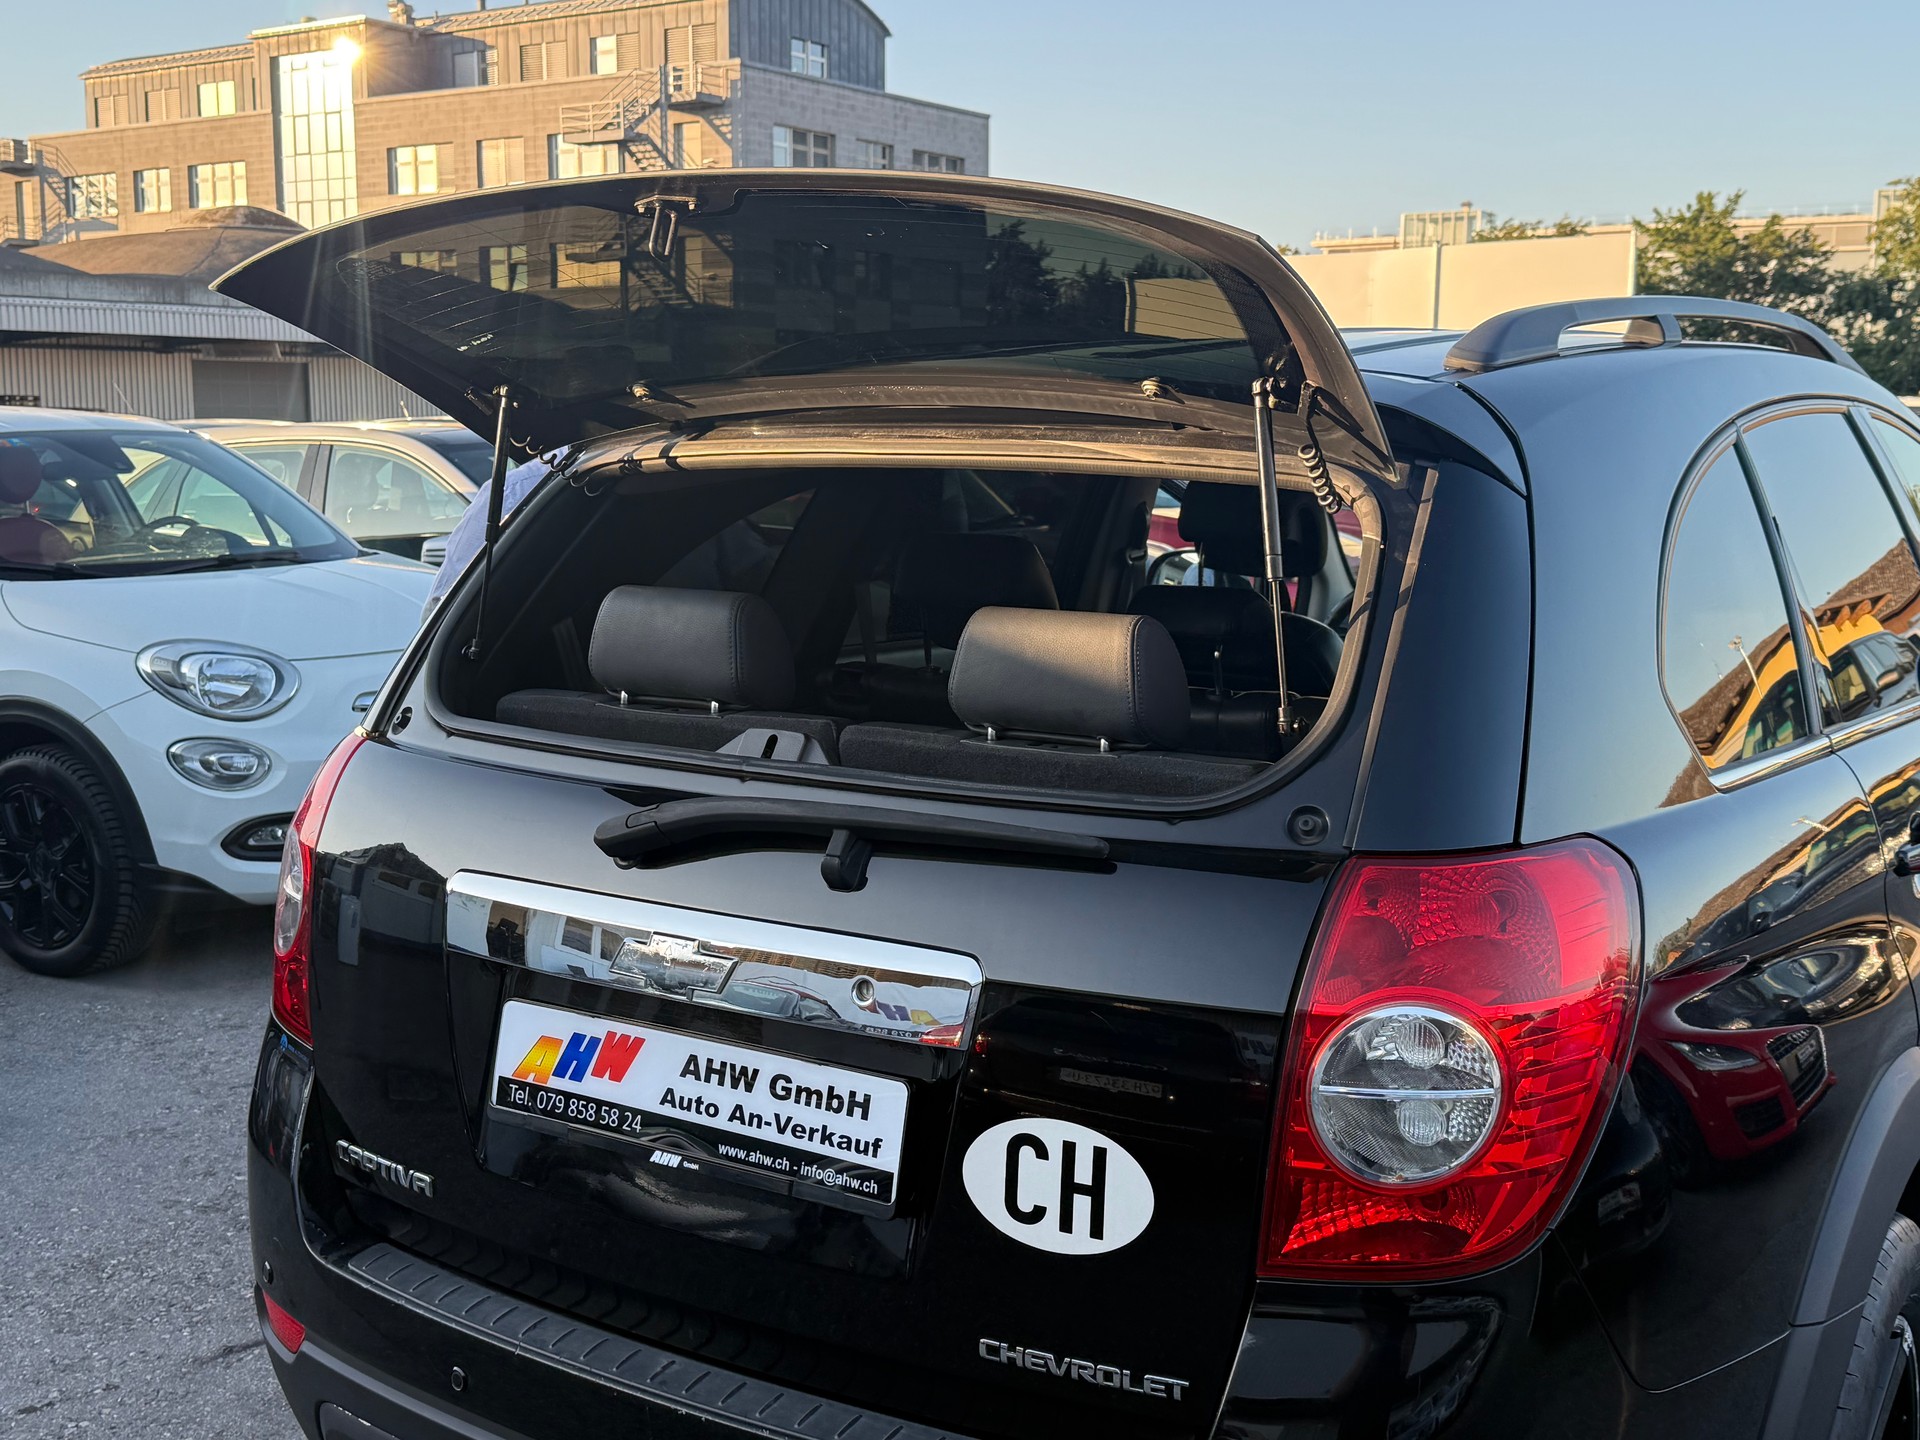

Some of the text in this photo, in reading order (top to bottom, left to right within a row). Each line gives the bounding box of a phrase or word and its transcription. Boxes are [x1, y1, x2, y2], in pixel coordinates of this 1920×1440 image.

[511, 1030, 646, 1085] AHW
[679, 1053, 872, 1121] AHW GmbH
[508, 1083, 642, 1133] Tel. 079 858 58 24
[658, 1087, 884, 1159] Auto An-Verkauf
[336, 1139, 434, 1198] CAPTIVA
[649, 1150, 683, 1169] AHW
[718, 1143, 790, 1172] www.ahw.ch
[800, 1161, 879, 1195] info@ahw.ch
[1004, 1132, 1108, 1241] CH
[978, 1338, 1190, 1401] CHEVROLET
